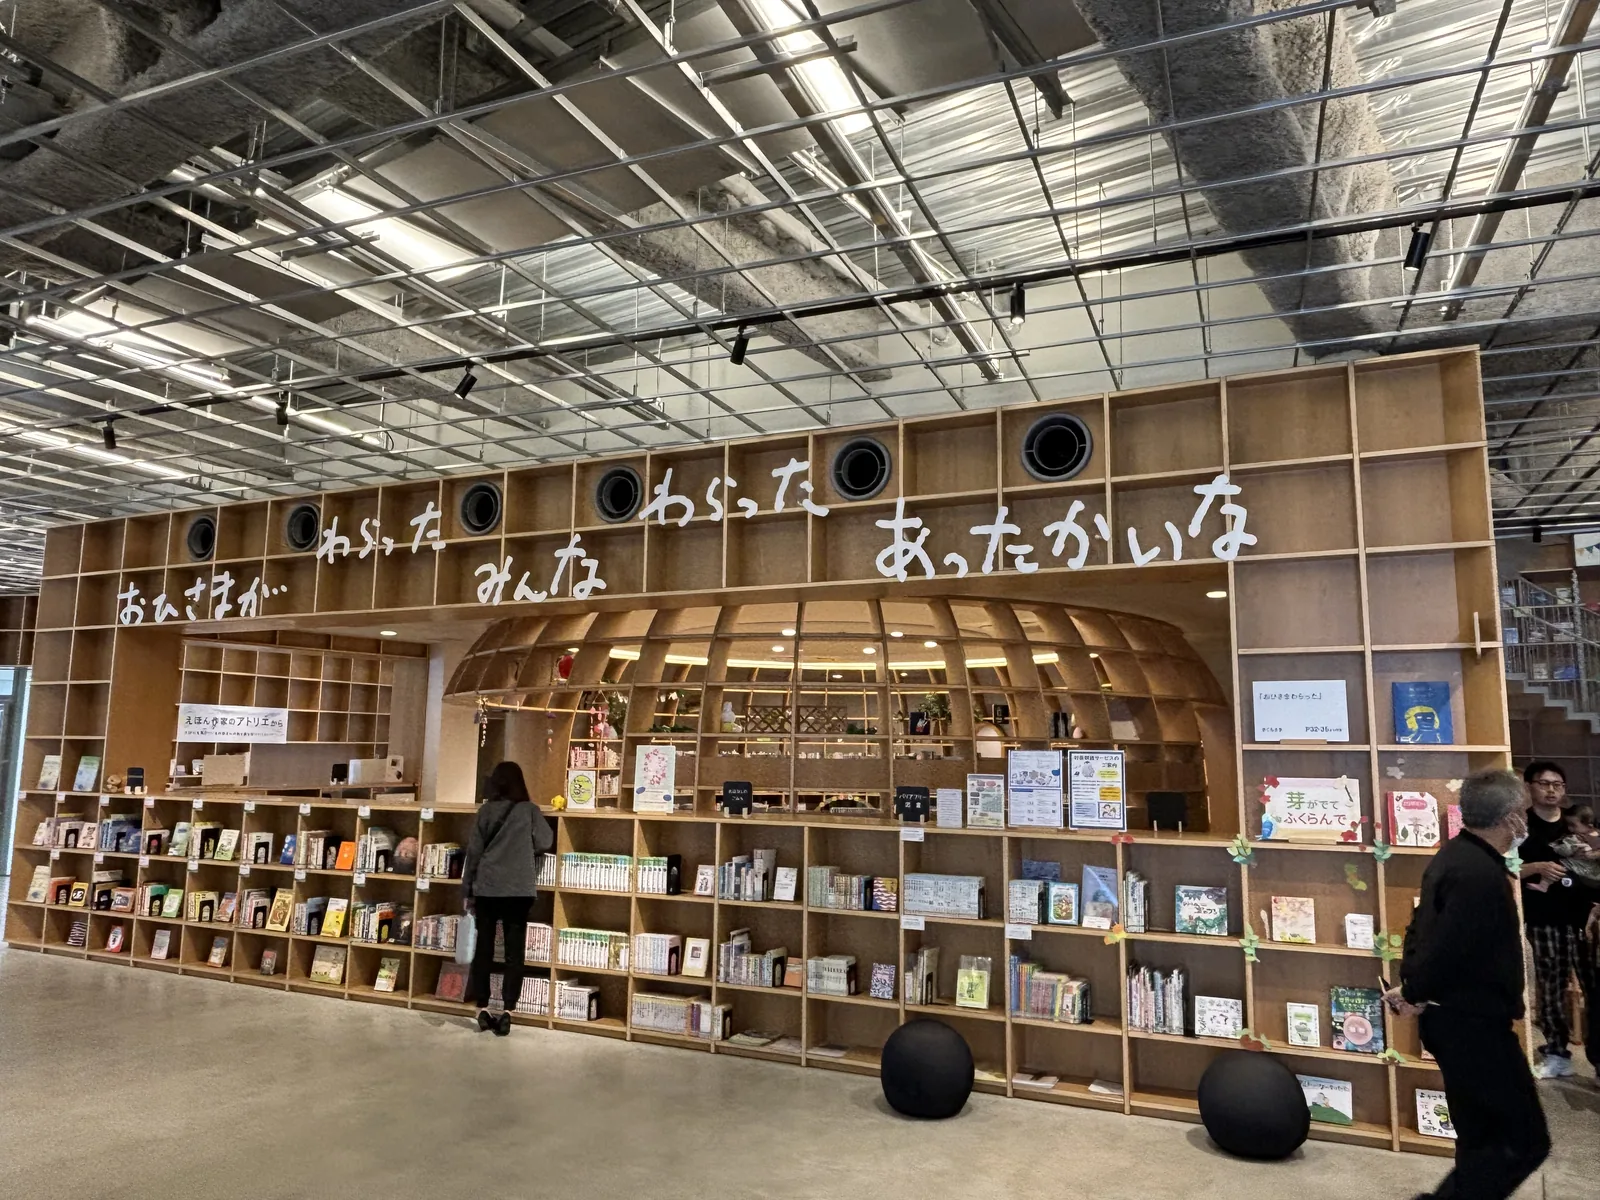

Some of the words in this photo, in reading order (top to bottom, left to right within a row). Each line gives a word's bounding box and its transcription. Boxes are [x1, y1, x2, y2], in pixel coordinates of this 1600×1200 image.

[639, 458, 829, 526] わらった
[317, 502, 447, 563] わらった
[876, 472, 1257, 582] あったかいな
[475, 534, 606, 605] みんな
[117, 571, 288, 627] おひさまが
[184, 715, 284, 729] えほん作家のアトリエから
[1284, 812, 1347, 826] ふくらんで
[1286, 791, 1340, 810] 芽がでて
